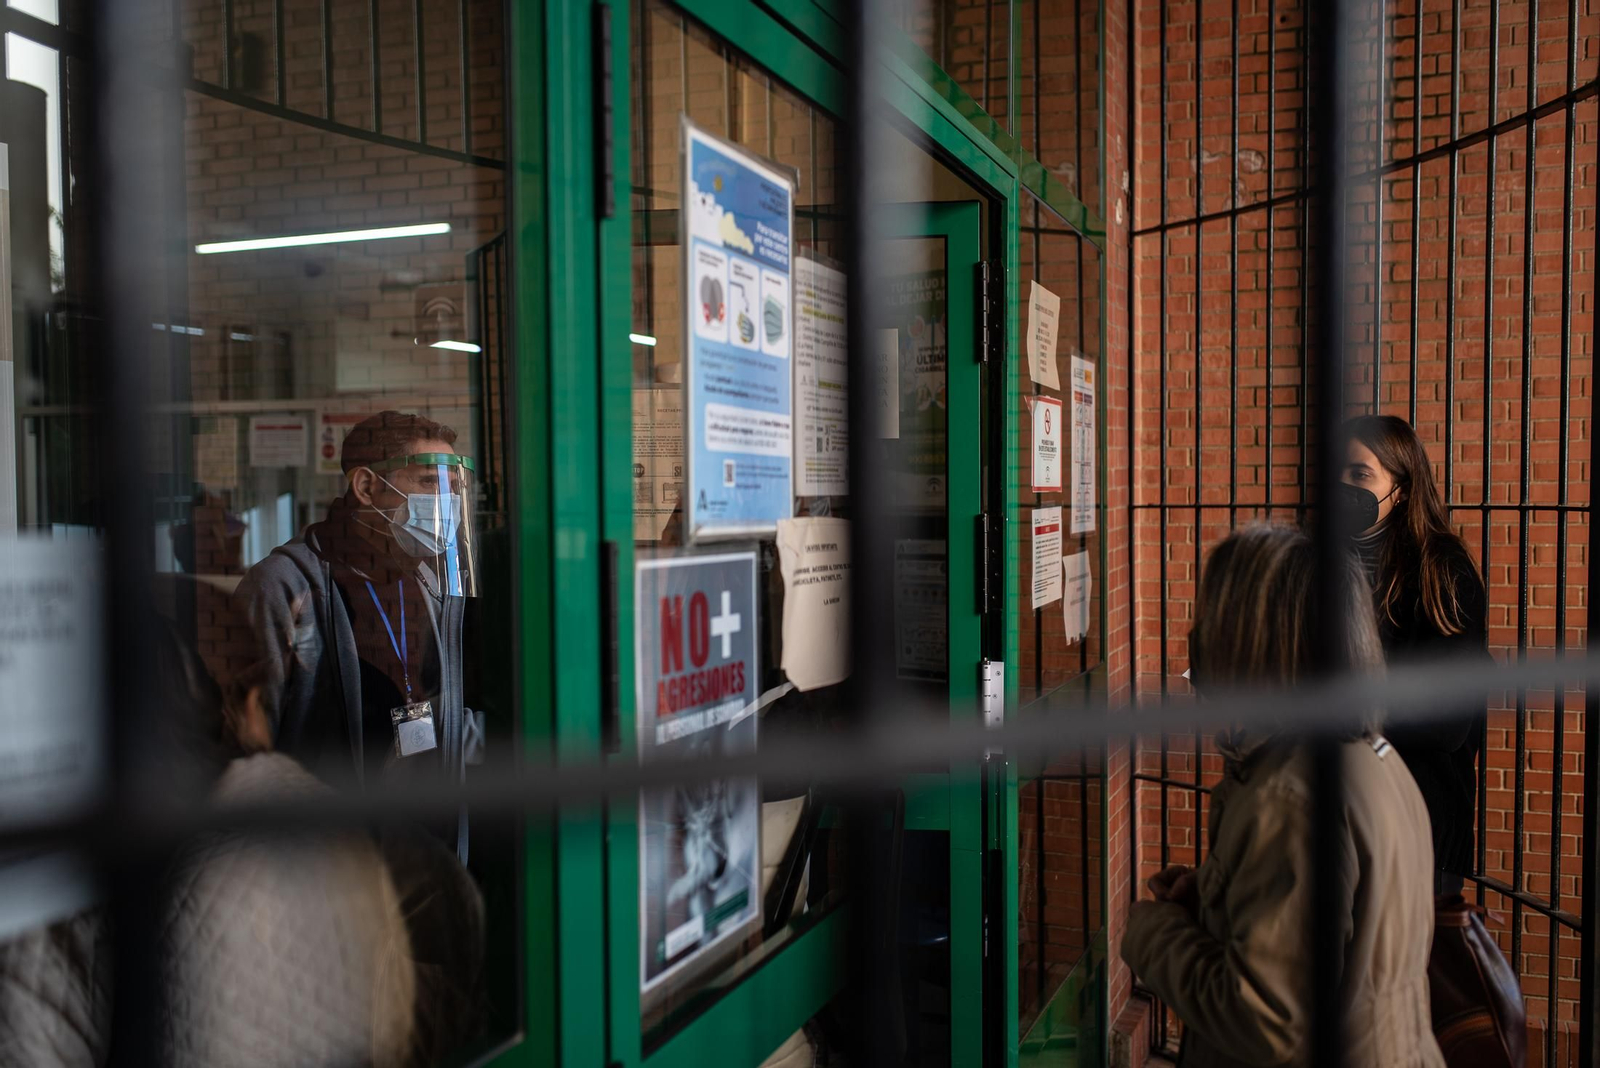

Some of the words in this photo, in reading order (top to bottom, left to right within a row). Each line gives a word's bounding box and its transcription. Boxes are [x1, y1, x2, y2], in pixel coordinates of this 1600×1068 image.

[907, 278, 939, 292] SALUD
[900, 291, 932, 305] DEJAR
[656, 660, 746, 720] AGRESIONES
